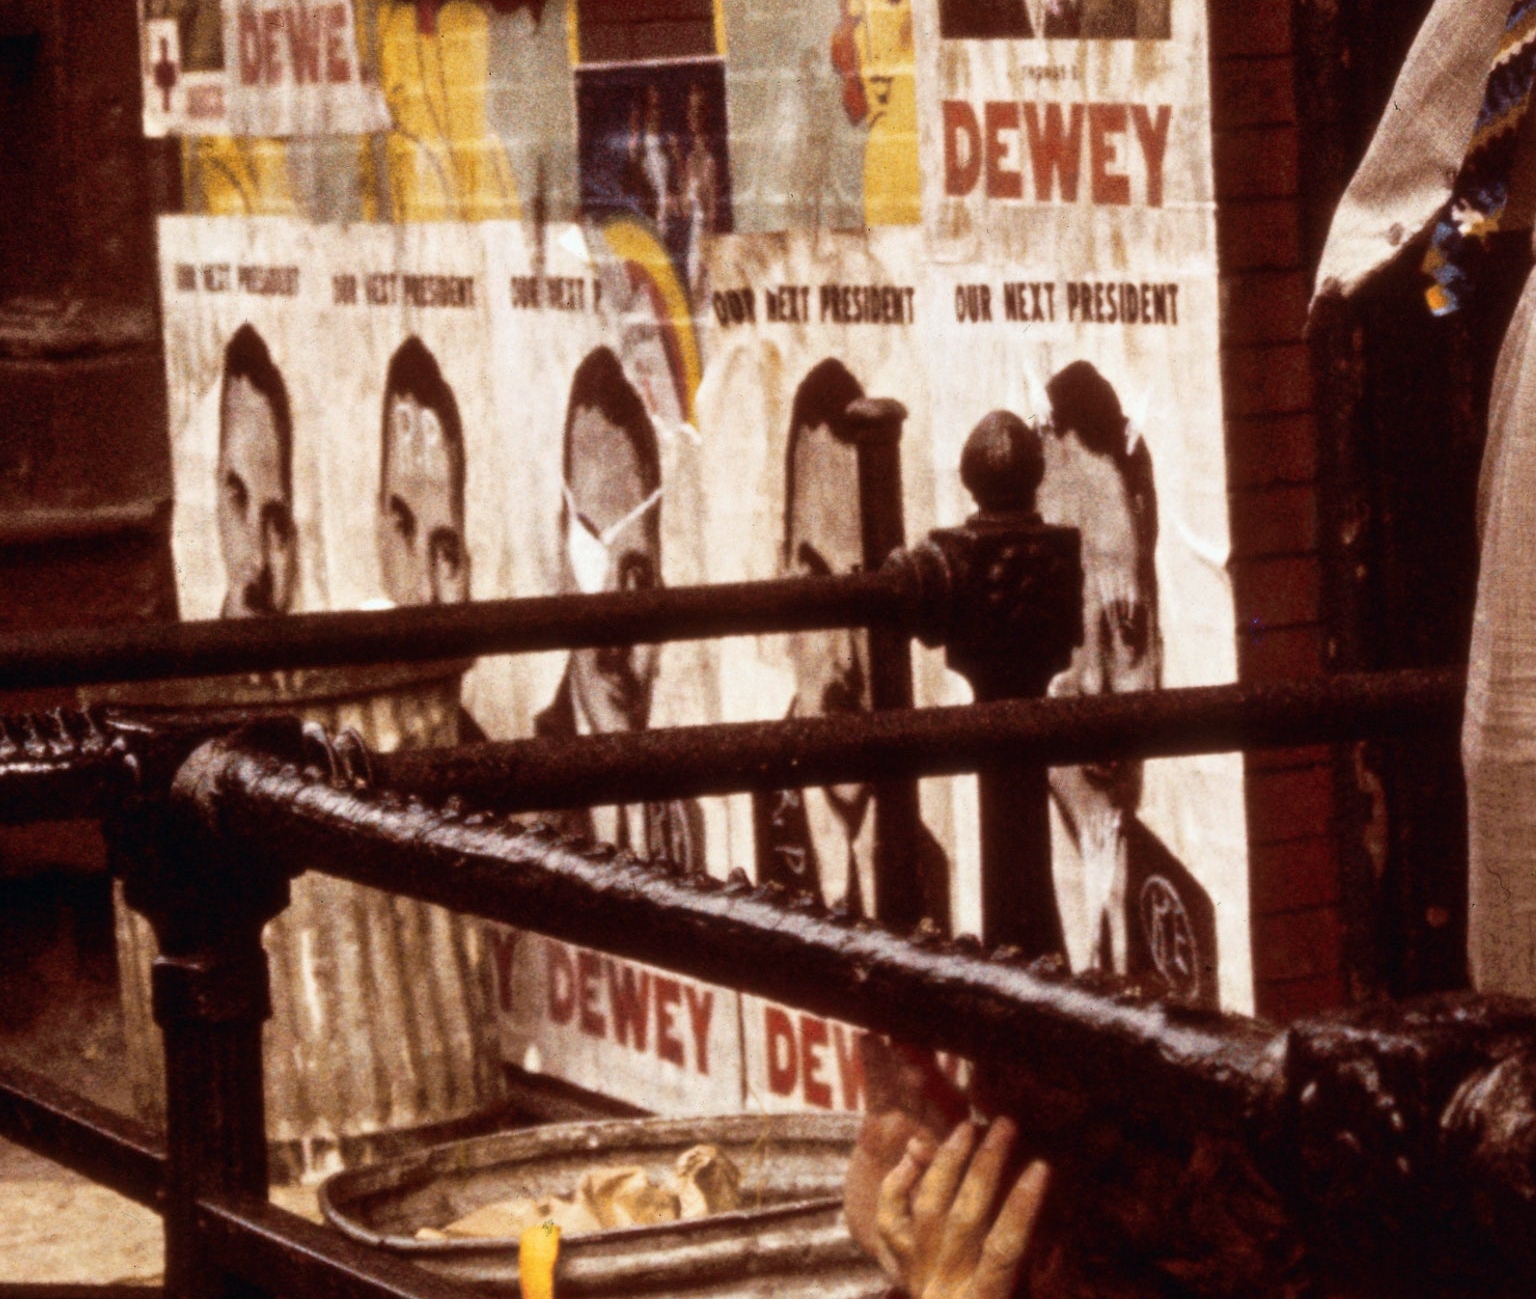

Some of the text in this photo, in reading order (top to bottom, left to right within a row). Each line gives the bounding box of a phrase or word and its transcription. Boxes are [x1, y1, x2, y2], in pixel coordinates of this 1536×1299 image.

[941, 100, 1173, 208] DEWEY
[955, 282, 1179, 326] OUR NEXT PRESIDENT
